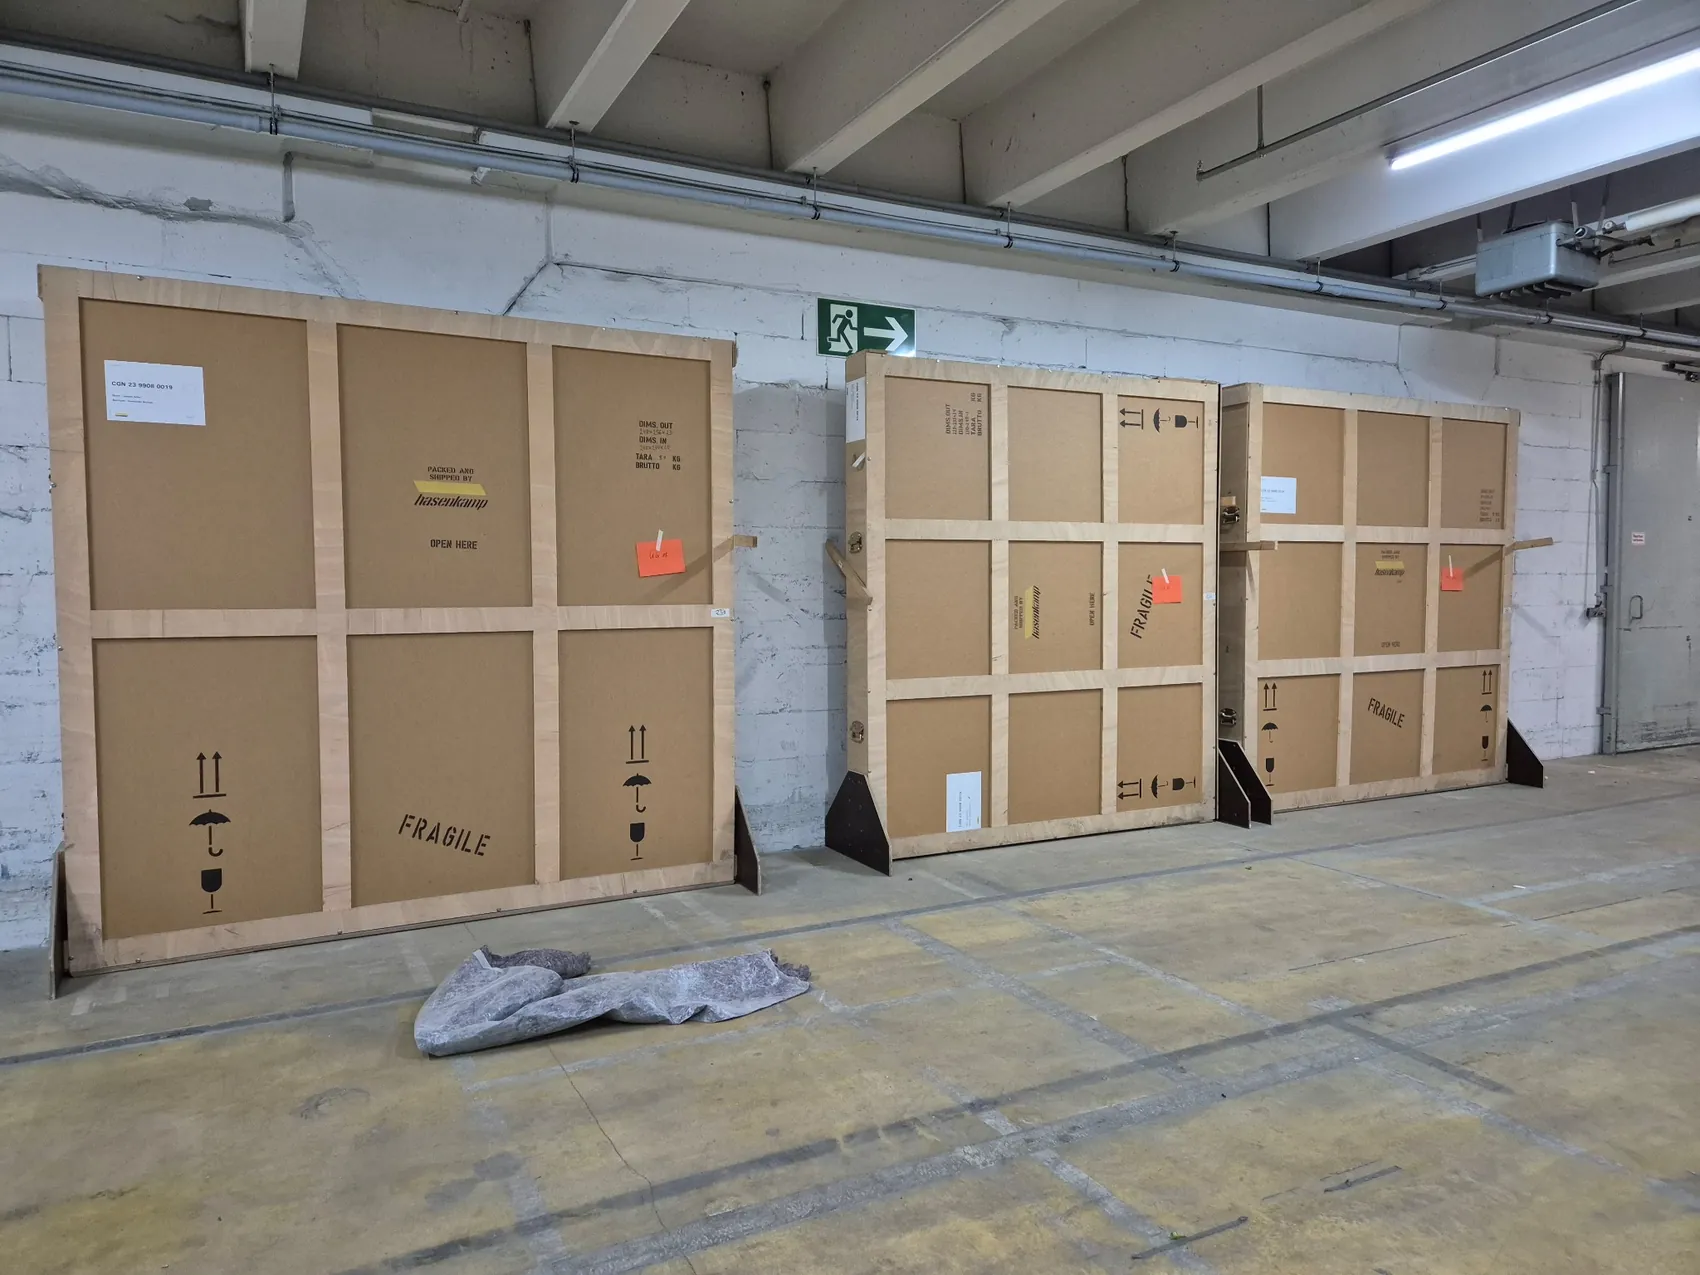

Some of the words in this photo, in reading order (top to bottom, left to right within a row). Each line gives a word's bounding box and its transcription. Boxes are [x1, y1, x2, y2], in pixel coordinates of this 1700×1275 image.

[660, 421, 673, 429] OUT
[635, 452, 653, 461] TARA
[427, 466, 456, 474] PACKED
[635, 461, 660, 470] BRUTTO
[672, 463, 681, 471] KG
[429, 474, 460, 482] SHIPPED
[413, 493, 489, 511] hasenkamp
[430, 538, 453, 549] OPEN
[455, 540, 478, 550] HERE
[1031, 585, 1041, 640] hasenkamp
[1367, 697, 1405, 729] FRAGILE
[397, 813, 491, 857] FRAGILE
